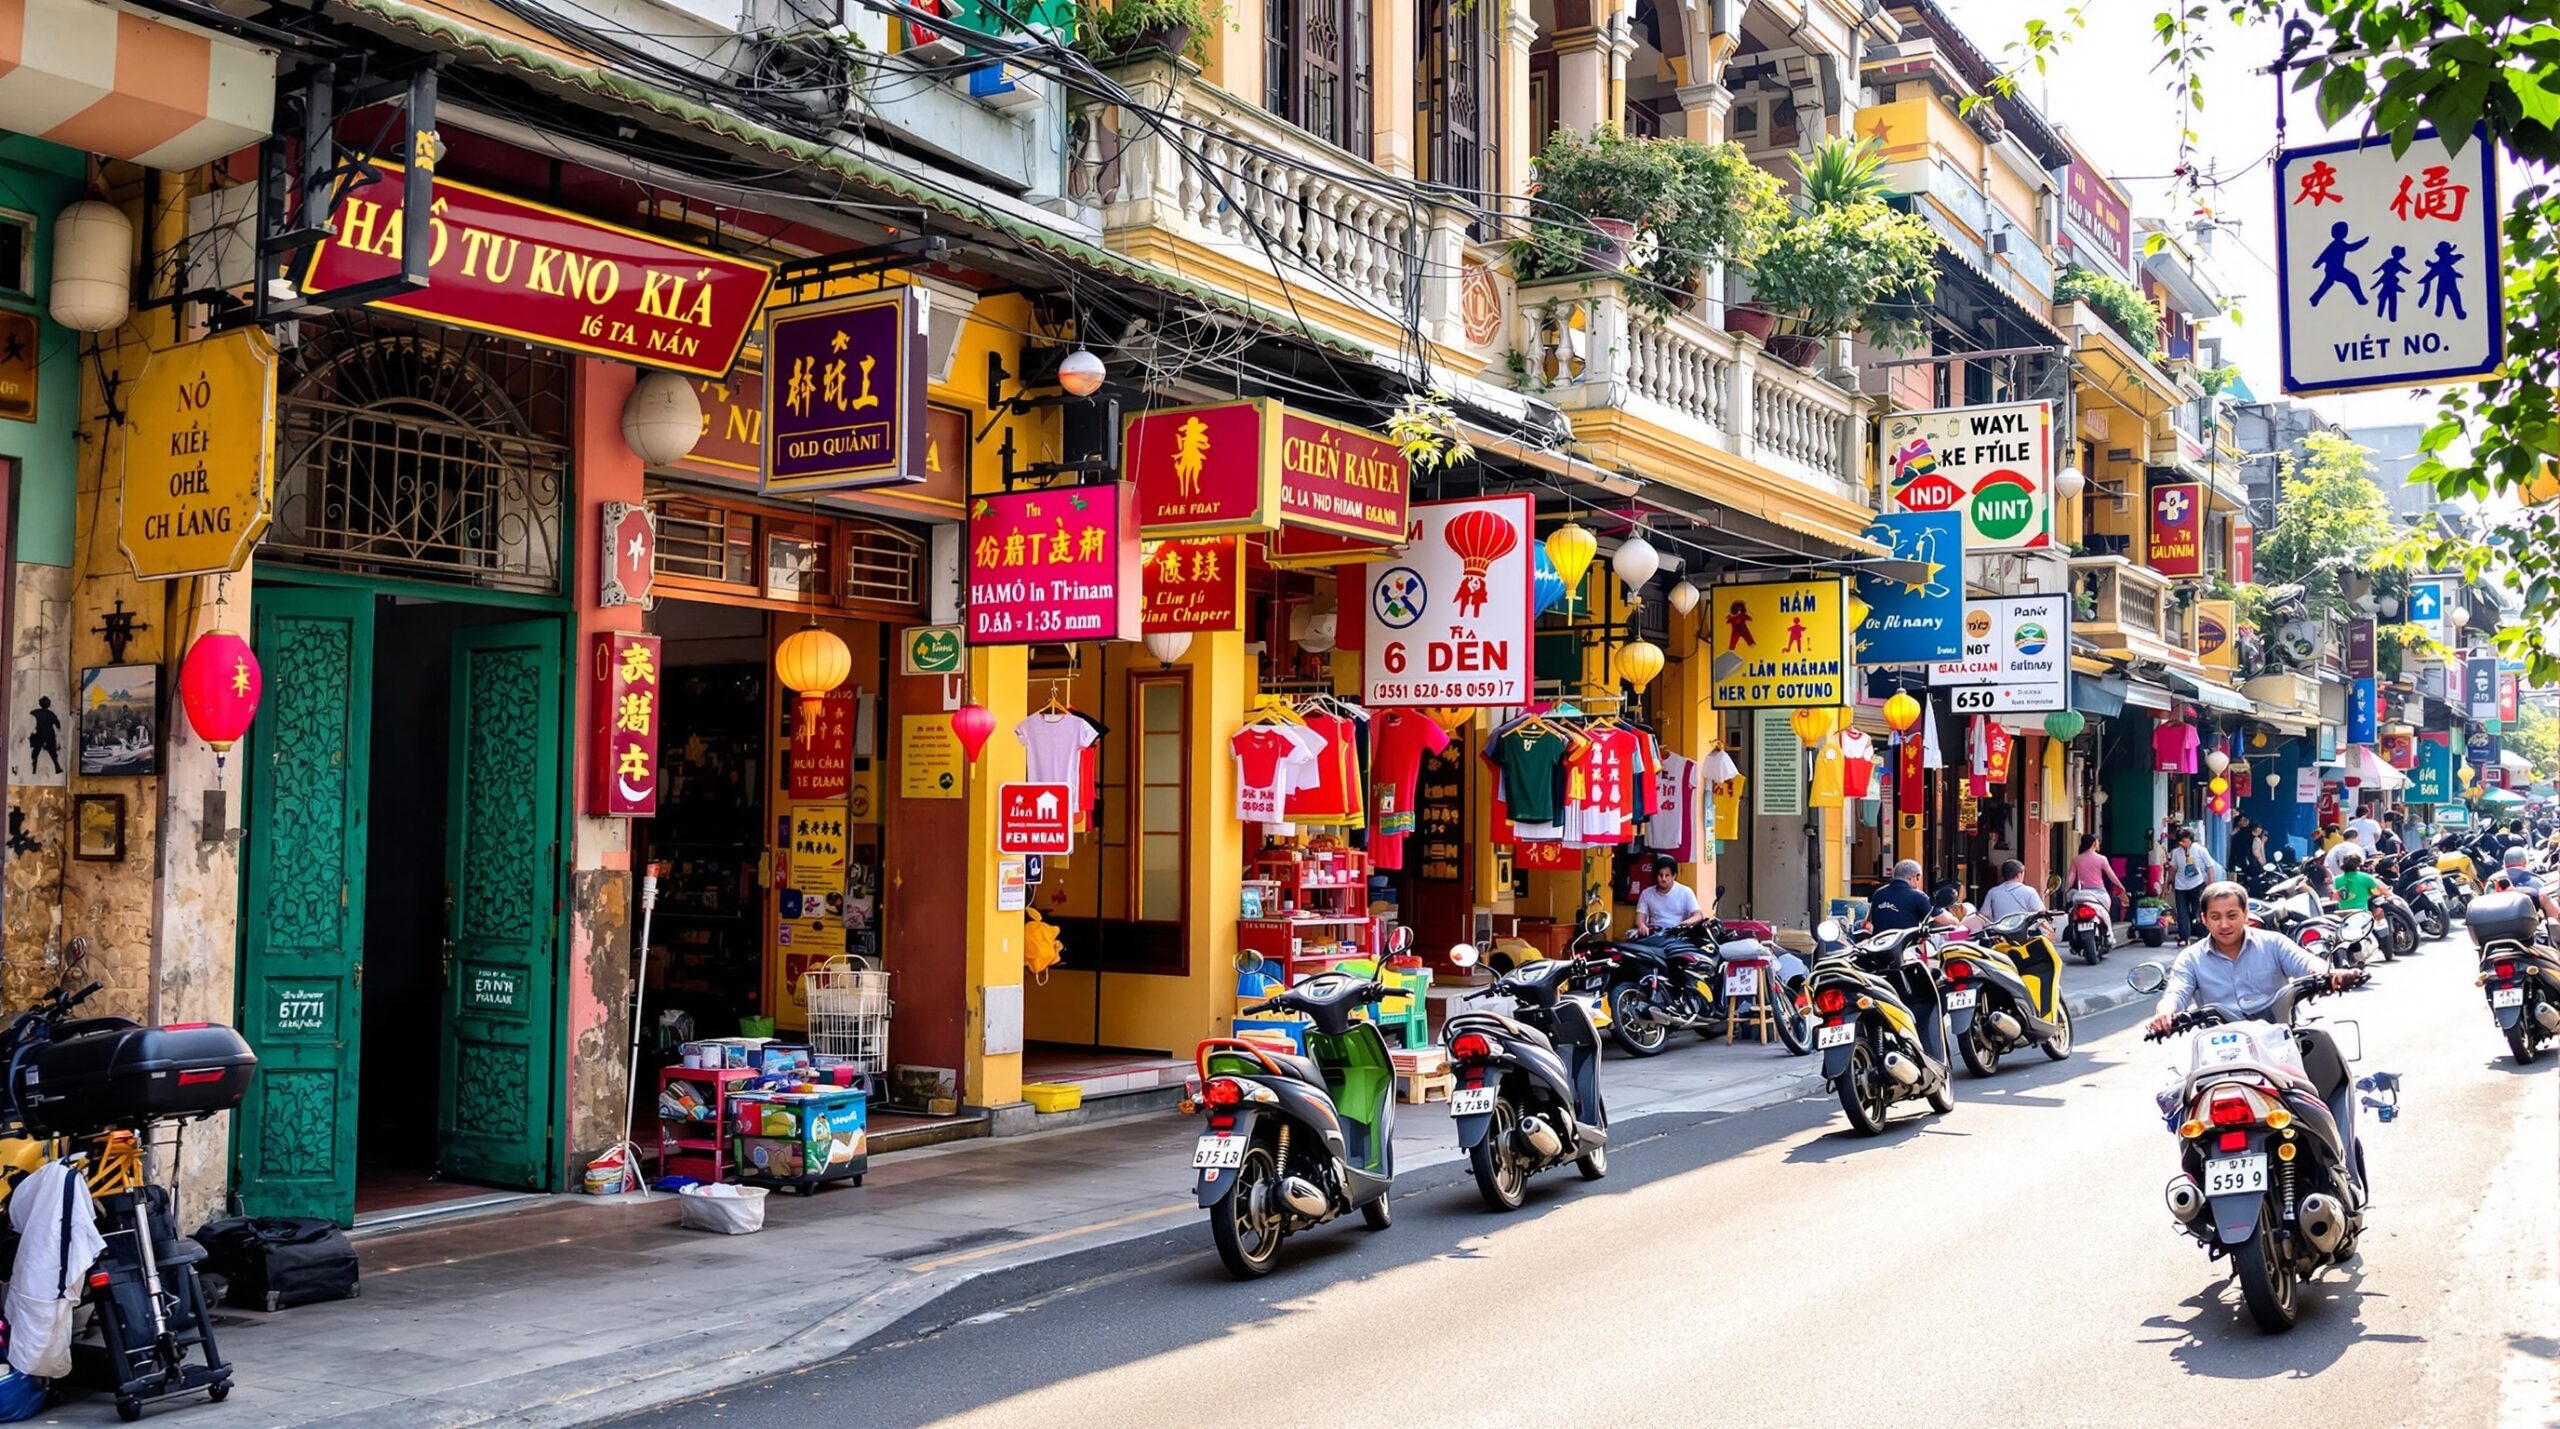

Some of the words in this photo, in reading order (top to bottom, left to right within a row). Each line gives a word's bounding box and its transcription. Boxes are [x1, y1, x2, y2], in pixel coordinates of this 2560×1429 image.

[461, 227, 520, 283] TU
[525, 245, 619, 305] KNO
[2403, 333, 2450, 356] NO.
[1971, 414, 2029, 436] WAYL
[789, 441, 819, 459] OLD
[1910, 486, 1953, 506] INDI
[1978, 499, 2029, 521] NINT
[1384, 641, 1407, 674] 6
[1719, 685, 1745, 701] HER
[1957, 691, 1994, 708] 650
